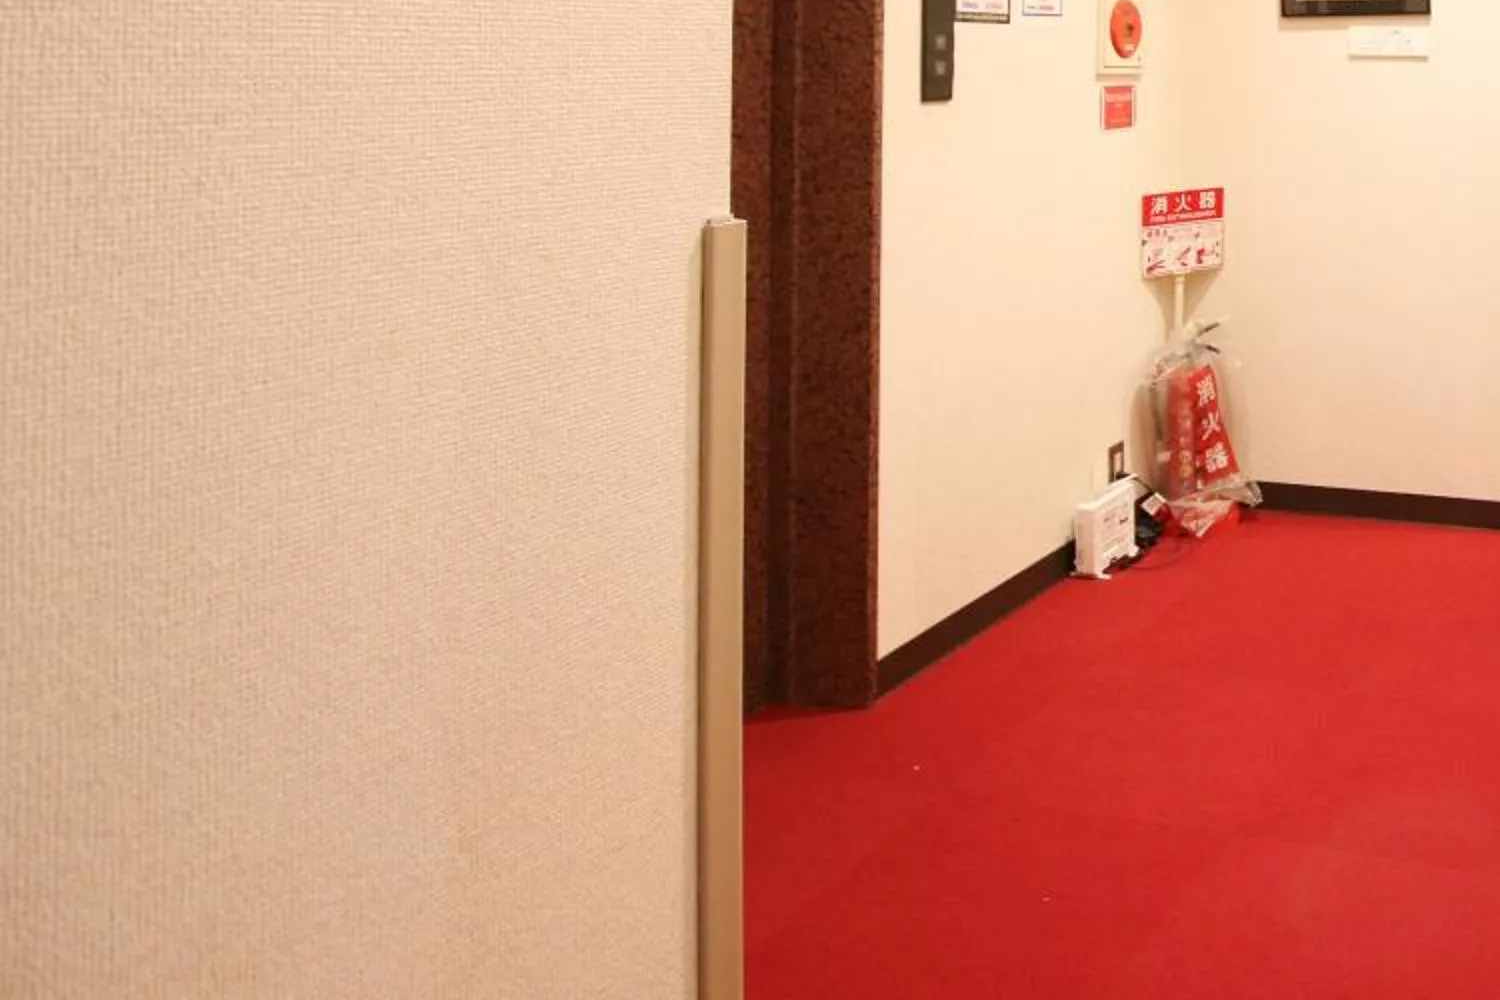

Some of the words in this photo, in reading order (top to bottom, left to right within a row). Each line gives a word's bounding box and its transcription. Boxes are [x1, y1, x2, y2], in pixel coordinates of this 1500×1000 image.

[1151, 191, 1216, 214] 消火器
[1196, 373, 1228, 473] 消火器
